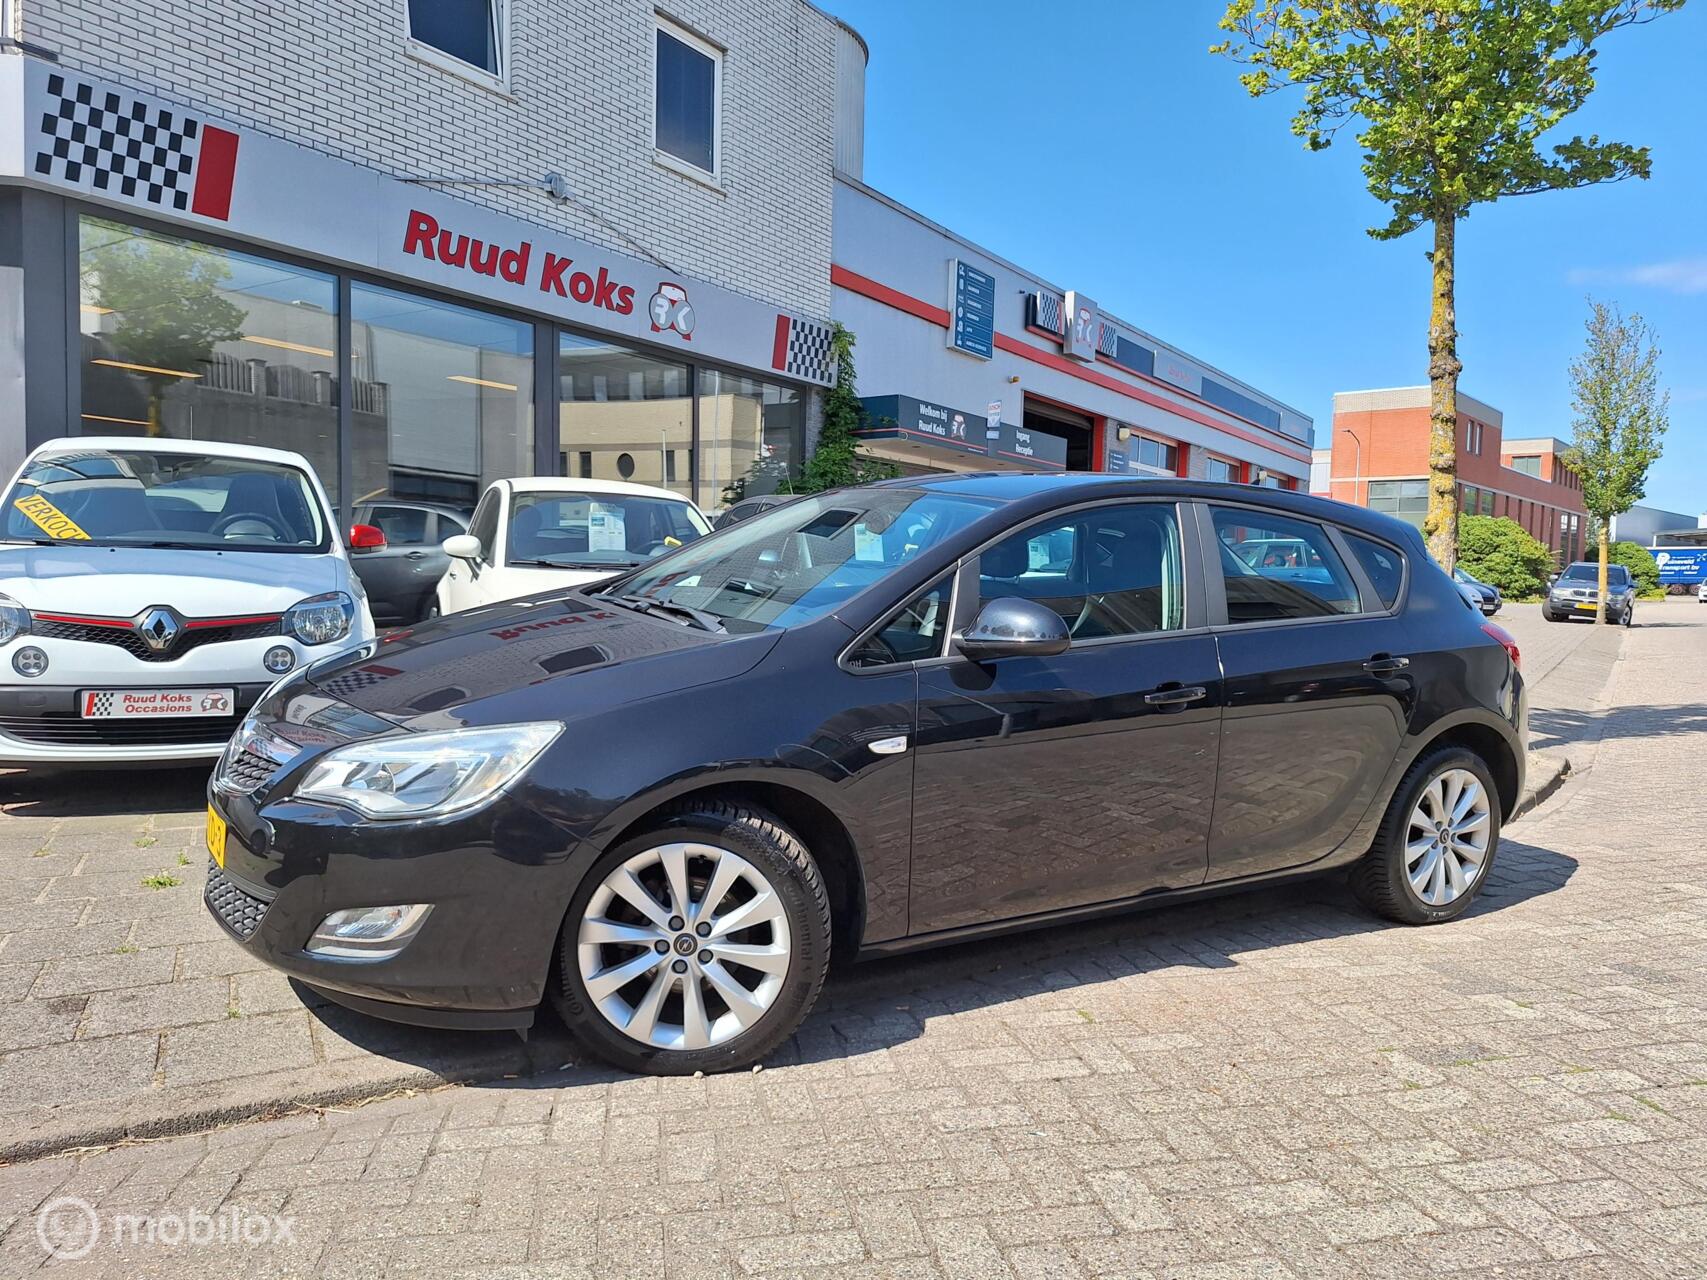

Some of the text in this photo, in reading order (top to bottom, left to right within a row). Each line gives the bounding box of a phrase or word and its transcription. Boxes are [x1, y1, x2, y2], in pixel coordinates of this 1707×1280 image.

[403, 209, 635, 315] Ruud Koks
[919, 403, 941, 419] Welkom
[918, 420, 946, 436] Ruud Koks
[19, 496, 87, 540] VERKOC
[123, 693, 192, 703] Ruud Koks
[125, 704, 192, 714] Occasions
